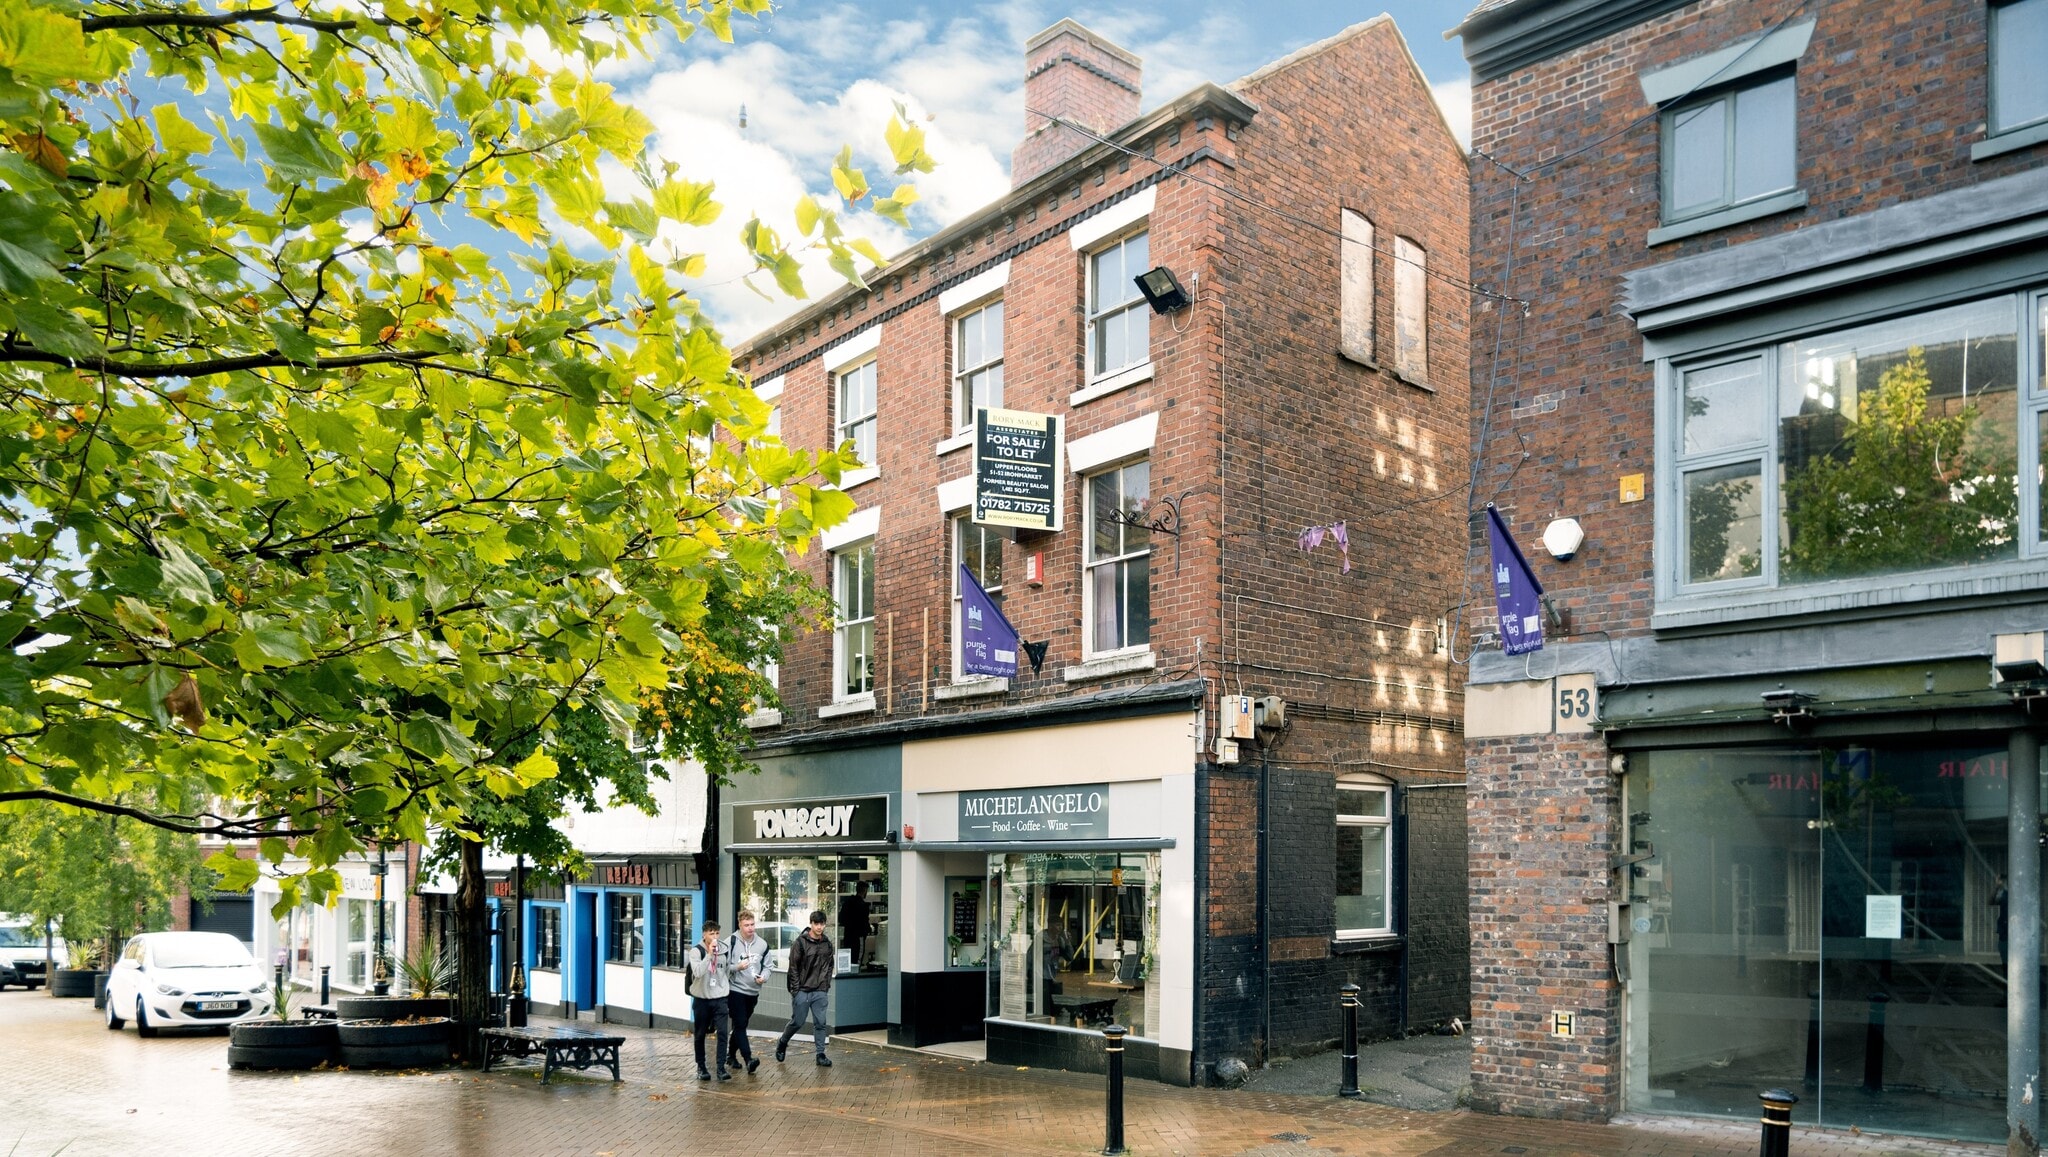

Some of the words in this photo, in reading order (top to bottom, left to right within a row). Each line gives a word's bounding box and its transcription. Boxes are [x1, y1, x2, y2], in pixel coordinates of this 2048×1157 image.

[992, 415, 1014, 424] RORY
[1018, 419, 1040, 427] MACK
[996, 426, 1038, 436] ASSOCIATES
[986, 434, 1010, 445] FOR
[1012, 436, 1040, 449] SALE
[997, 446, 1013, 456] TO
[1015, 449, 1036, 459] LET
[1004, 472, 1042, 480] IRONMARKET
[980, 498, 1011, 510] 01782
[1014, 501, 1050, 514] 715725
[1560, 688, 1590, 719] 53
[964, 792, 1102, 817] MICHELANGELO
[753, 804, 855, 839] TONI&GUY
[992, 822, 1010, 832] Food
[1016, 820, 1040, 831] Coffee
[1047, 820, 1068, 830] Wine
[606, 866, 650, 885] REFLEX
[1556, 1014, 1572, 1035] H
